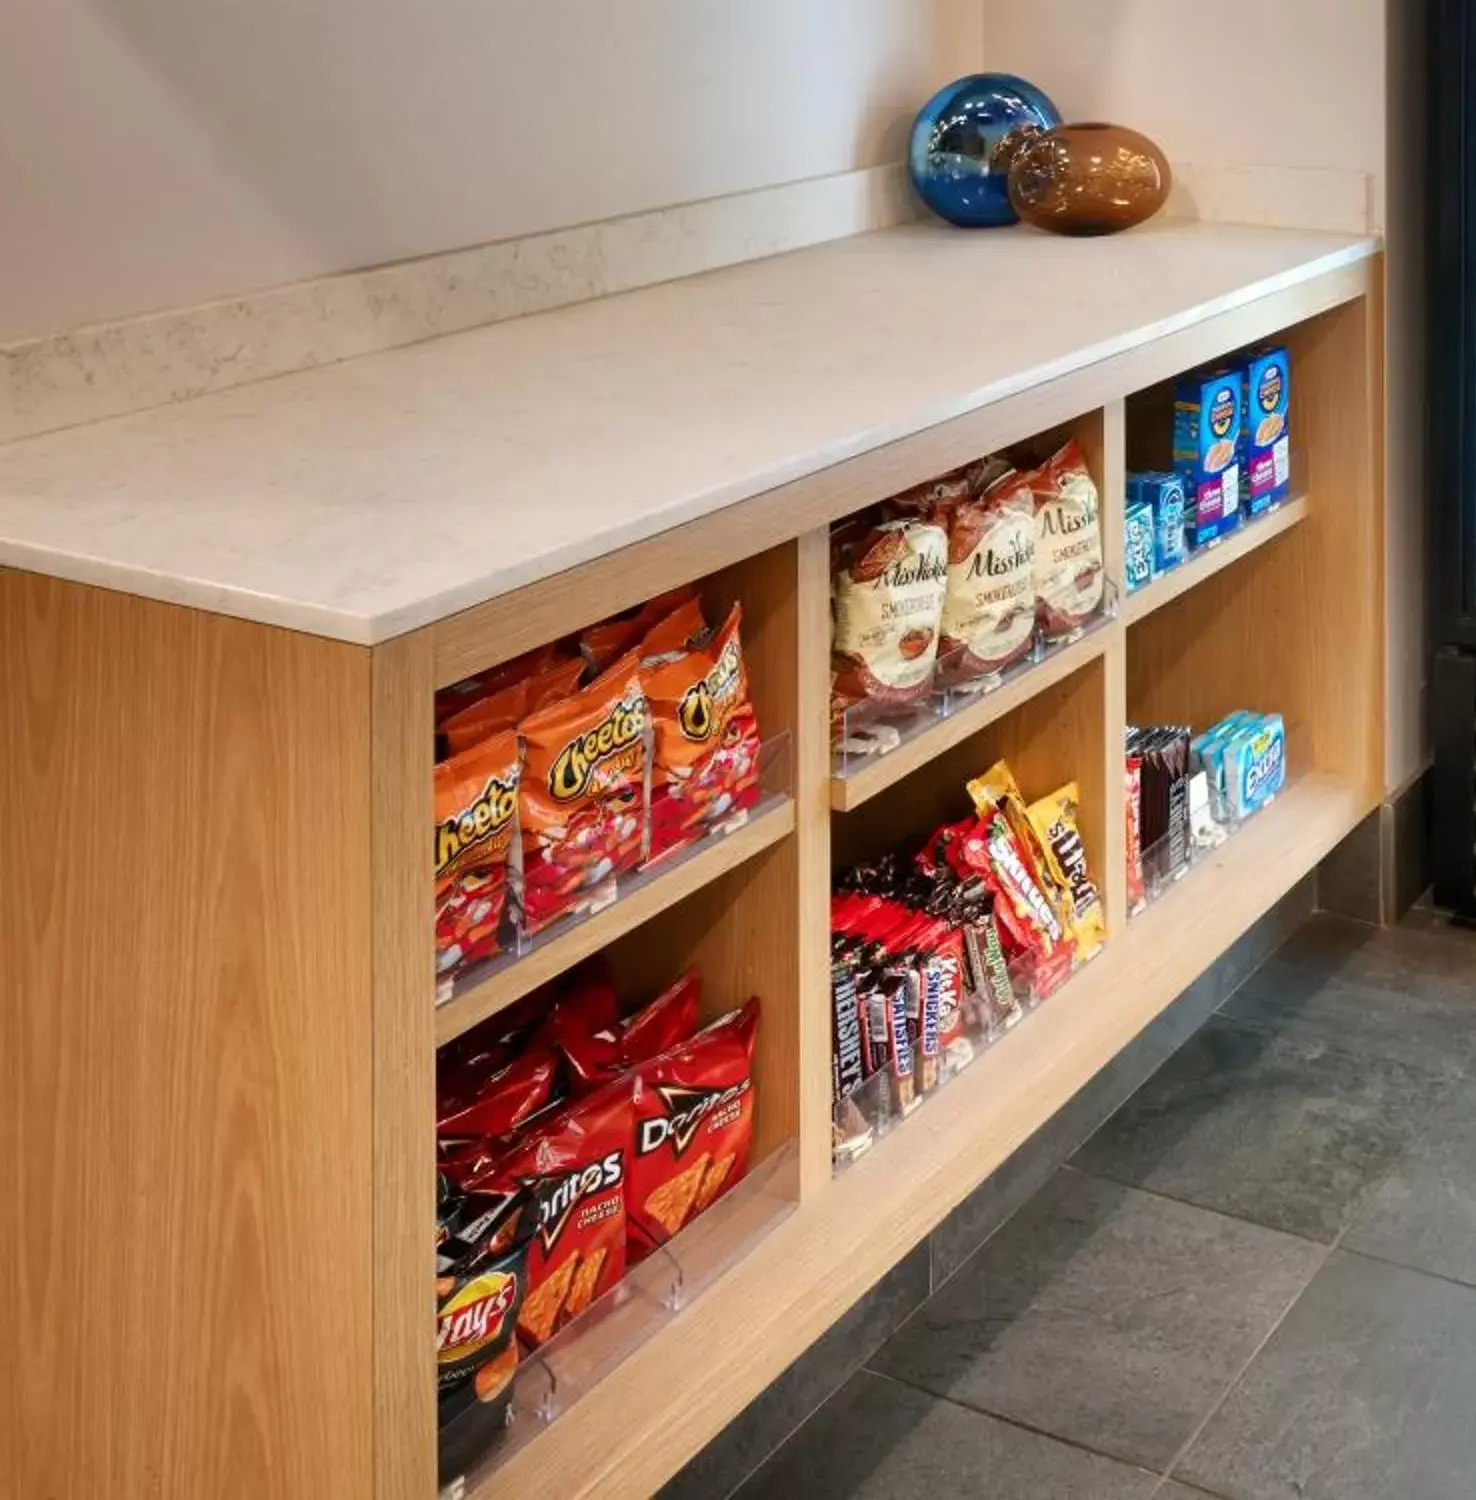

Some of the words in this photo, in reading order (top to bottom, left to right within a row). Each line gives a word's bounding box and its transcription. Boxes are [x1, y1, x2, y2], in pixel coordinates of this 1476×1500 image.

[1040, 506, 1086, 539] Miss
[964, 549, 1009, 581] Miss
[550, 698, 646, 801] Cheetos
[435, 777, 519, 869] heeto
[989, 834, 1061, 943] Skittles
[833, 978, 863, 1098] HERSHEY'S
[922, 969, 942, 1055] SNICKERS
[641, 1078, 752, 1154] Doritos
[576, 1208, 623, 1230] CHEESE
[580, 1194, 623, 1218] NACHO
